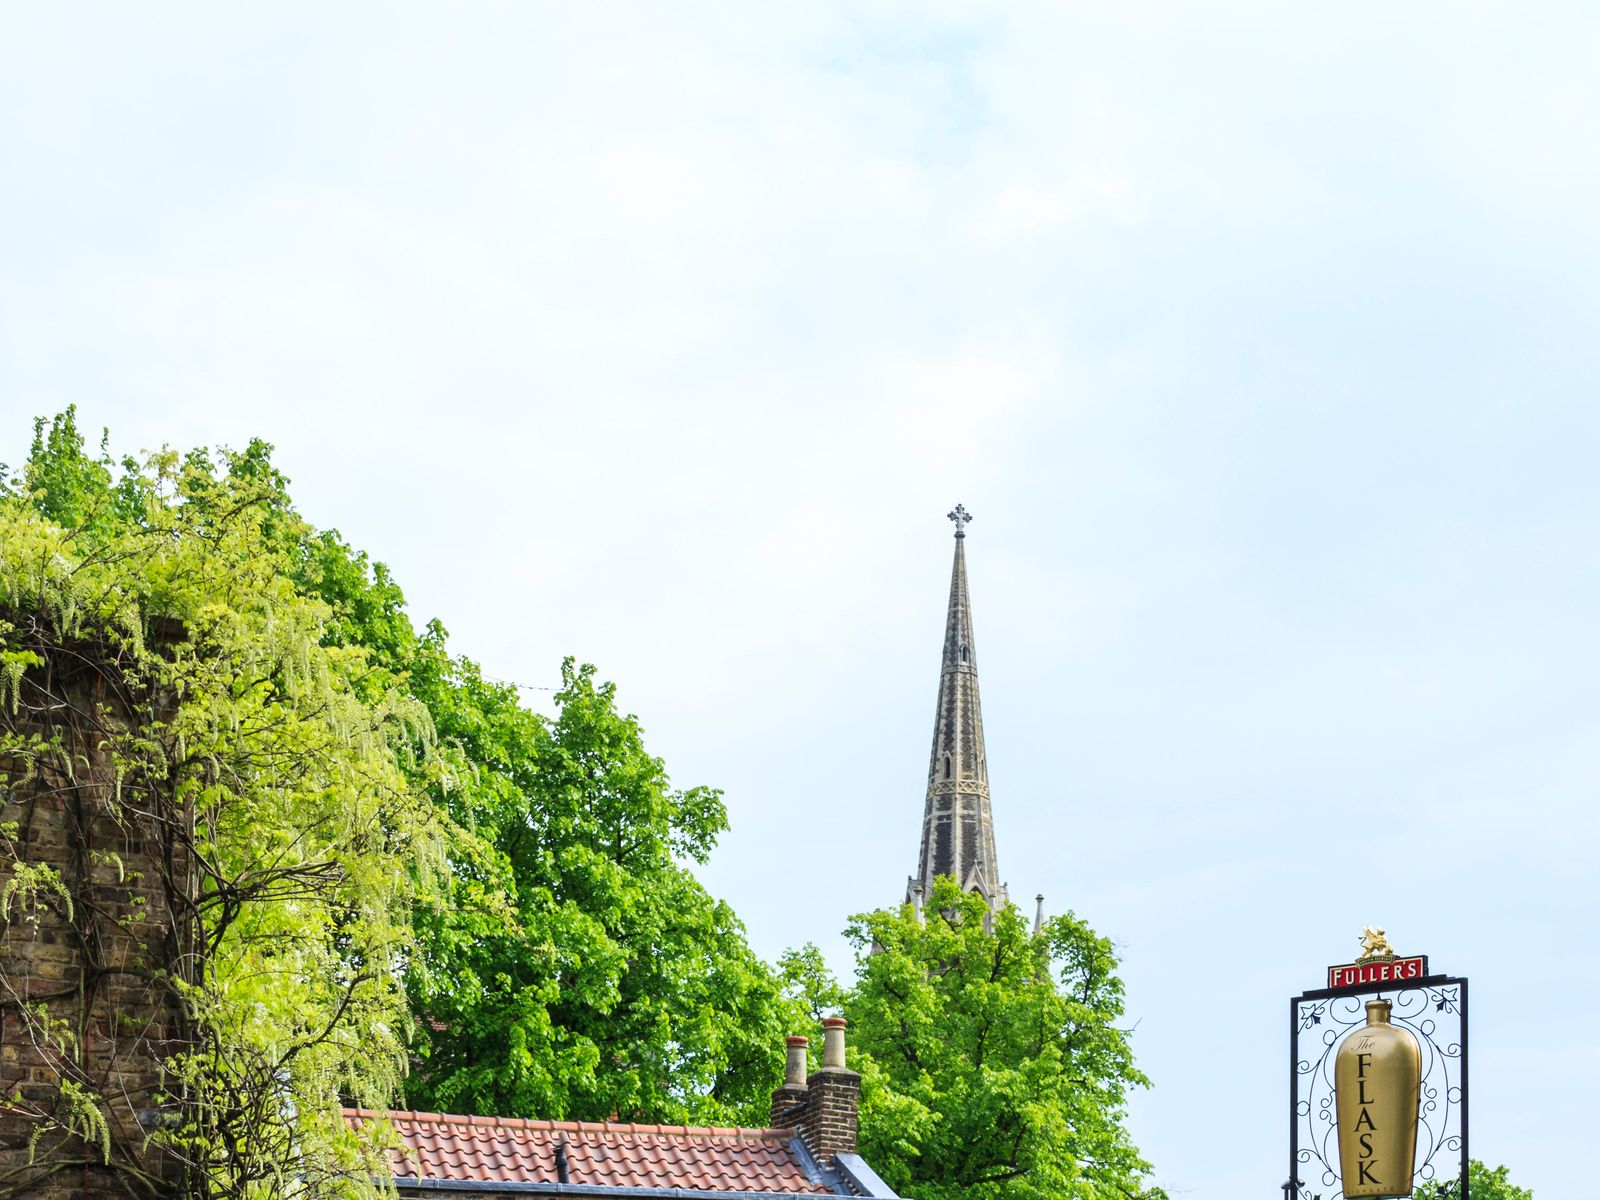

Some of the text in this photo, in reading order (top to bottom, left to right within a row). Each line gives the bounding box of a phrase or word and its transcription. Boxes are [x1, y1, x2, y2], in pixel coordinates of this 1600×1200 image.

[1333, 961, 1417, 986] FULLER'S
[1351, 1035, 1376, 1051] The
[1353, 1053, 1382, 1185] FLASK
